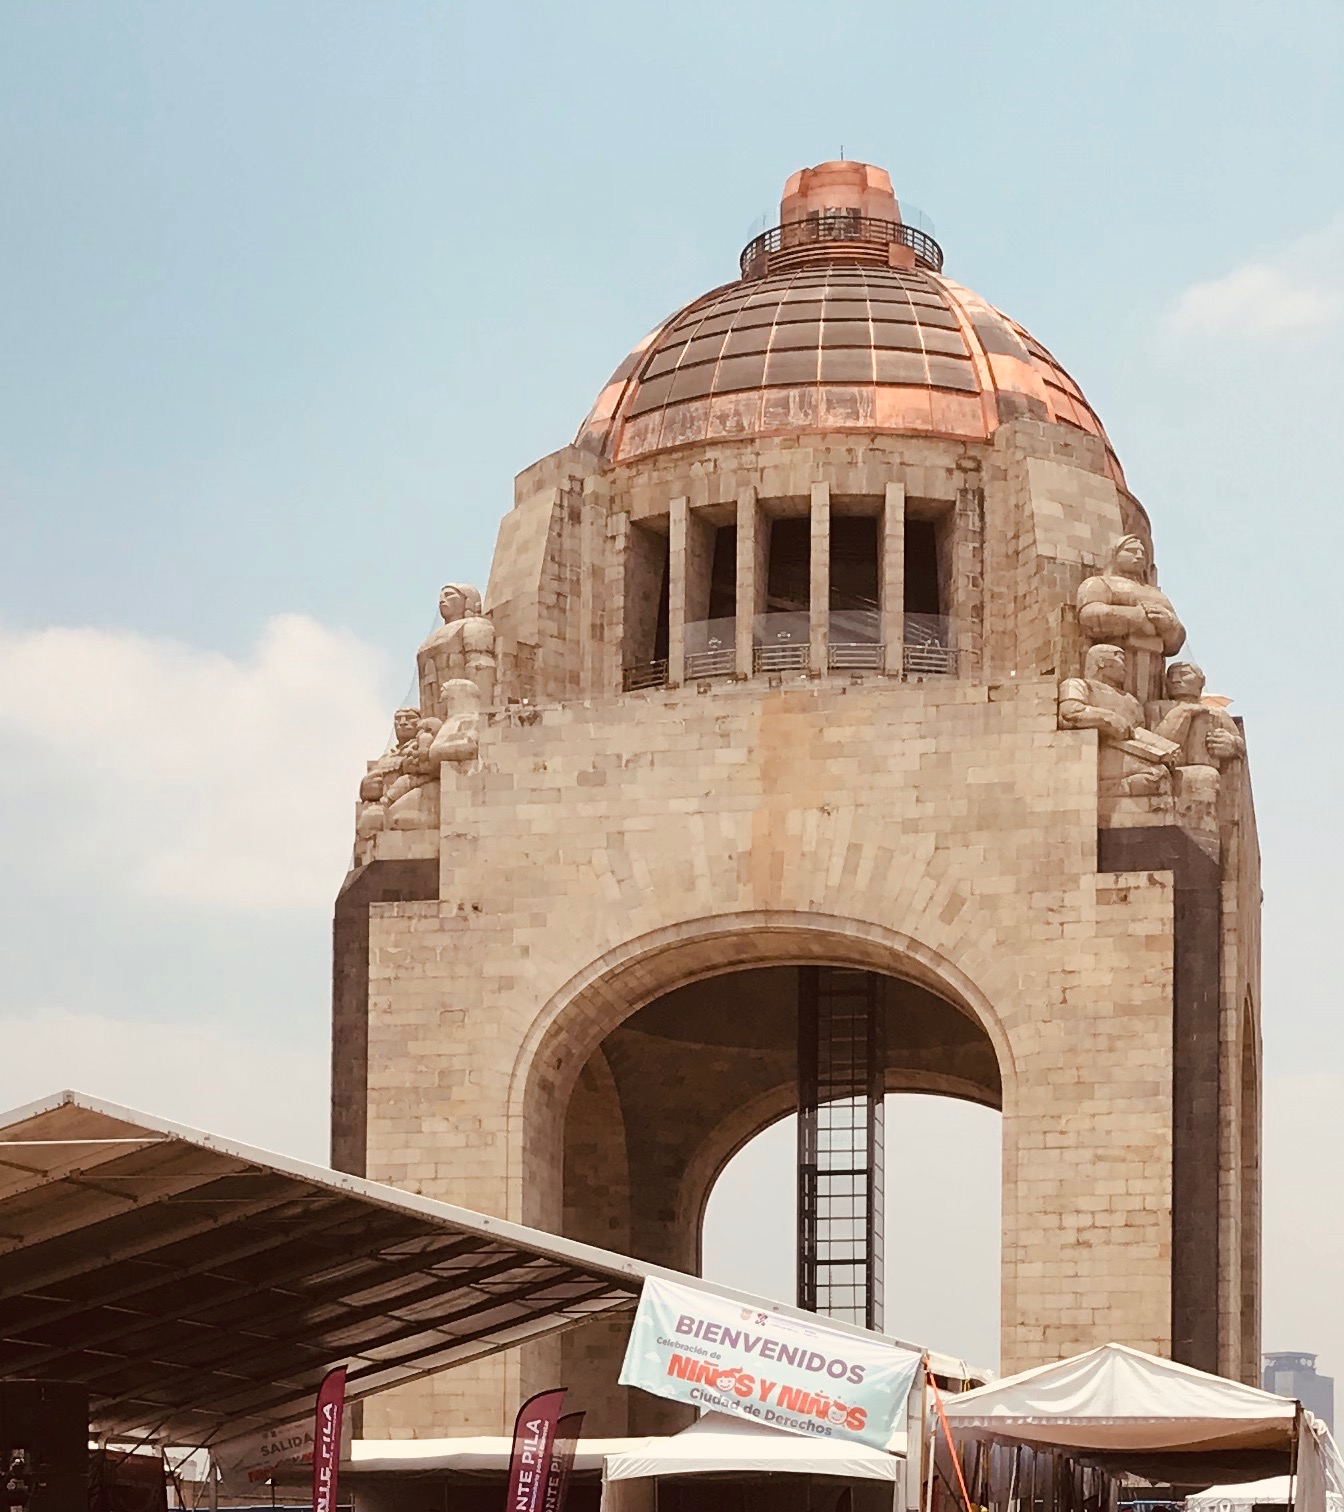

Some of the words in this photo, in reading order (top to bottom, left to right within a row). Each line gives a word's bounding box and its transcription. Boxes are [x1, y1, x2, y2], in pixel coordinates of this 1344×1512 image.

[656, 1336, 708, 1356] Celebración
[709, 1352, 722, 1360] de
[675, 1314, 866, 1385] BIENVENIDOS
[758, 1378, 777, 1404] Y
[689, 1387, 741, 1411] Ciudad
[743, 1404, 761, 1417] de
[764, 1409, 833, 1437] Derechos
[260, 1432, 315, 1457] SALIDA
[521, 1419, 542, 1465] PILA
